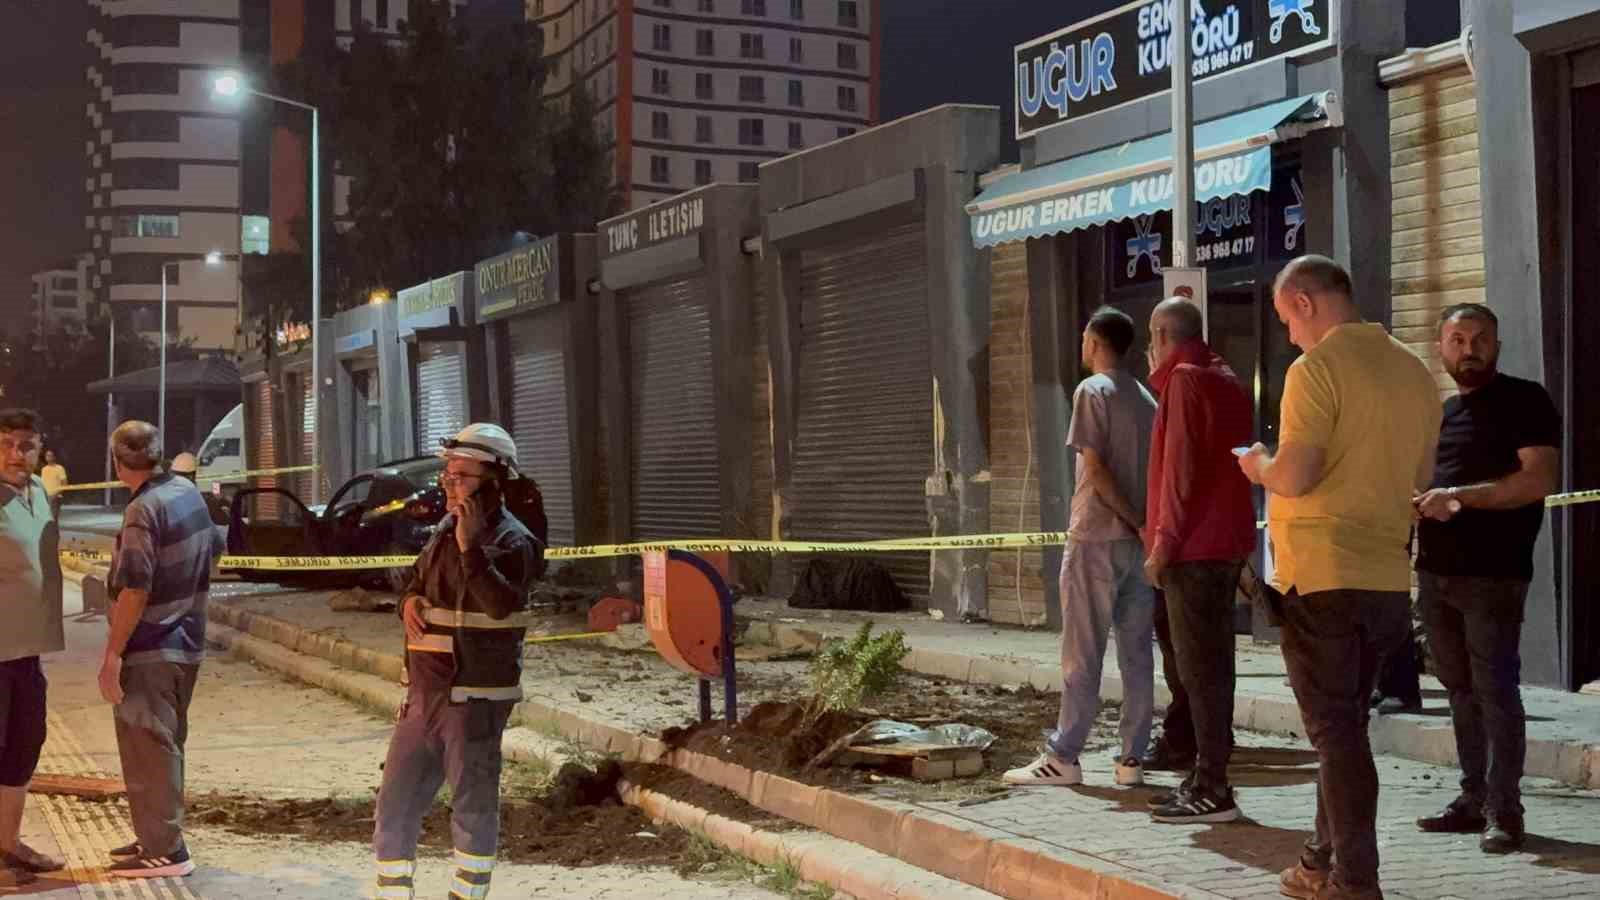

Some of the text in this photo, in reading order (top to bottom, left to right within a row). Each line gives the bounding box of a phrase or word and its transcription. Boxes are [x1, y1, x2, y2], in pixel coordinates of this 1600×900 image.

[1137, 0, 1206, 39] ERKK
[1210, 51, 1229, 71] 968
[1230, 44, 1242, 64] 47
[1243, 40, 1254, 59] 17
[1039, 187, 1116, 226] ERKEK
[1212, 240, 1231, 259] 968
[1232, 237, 1244, 255] 47
[1244, 236, 1255, 253] 17
